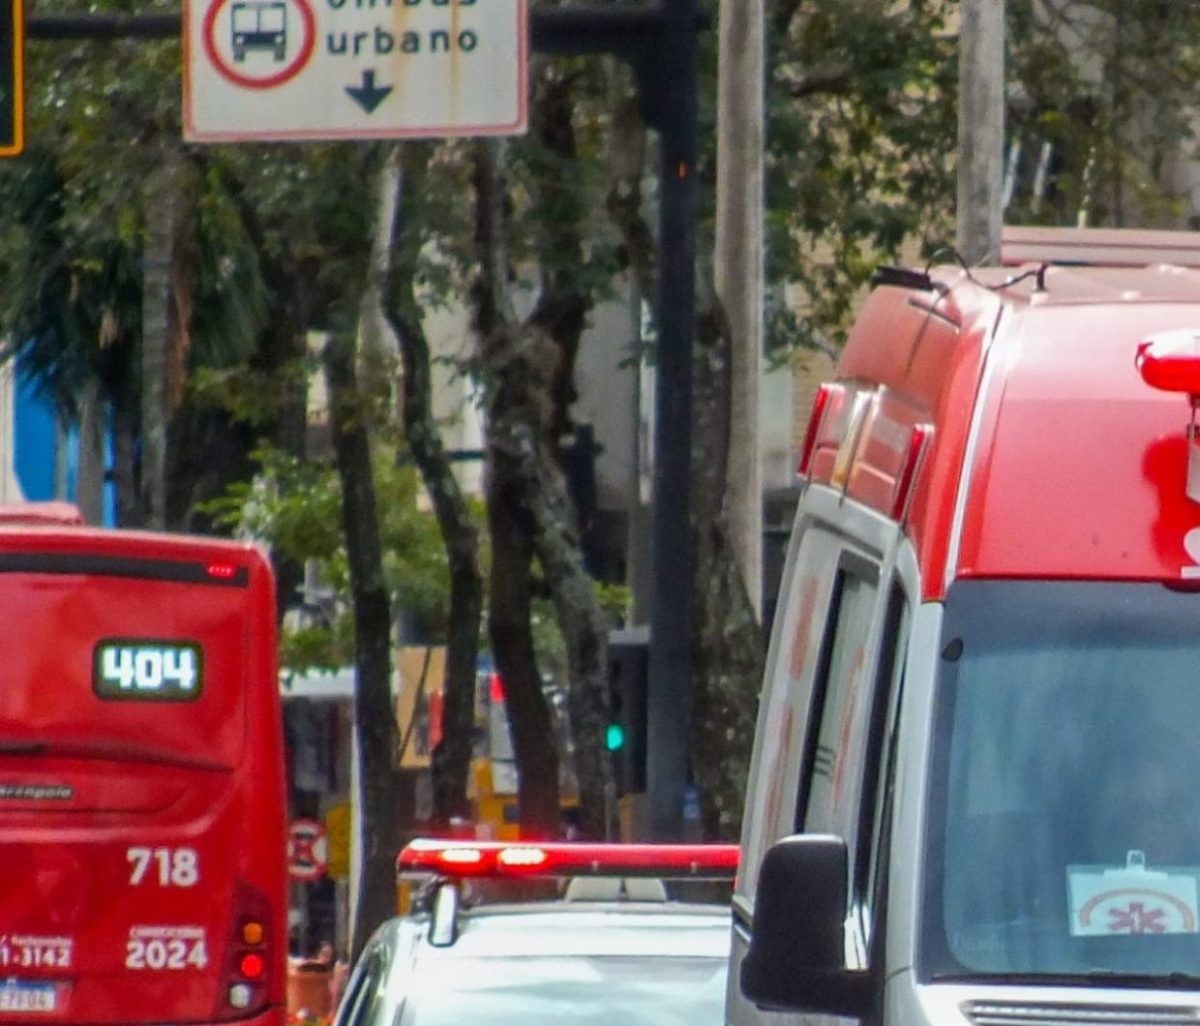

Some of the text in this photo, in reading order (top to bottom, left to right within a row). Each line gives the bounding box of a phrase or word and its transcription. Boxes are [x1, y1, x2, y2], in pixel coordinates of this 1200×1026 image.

[327, 25, 478, 55] urbano
[103, 648, 195, 689] 404
[126, 847, 199, 887] 718
[126, 940, 207, 970] 2024
